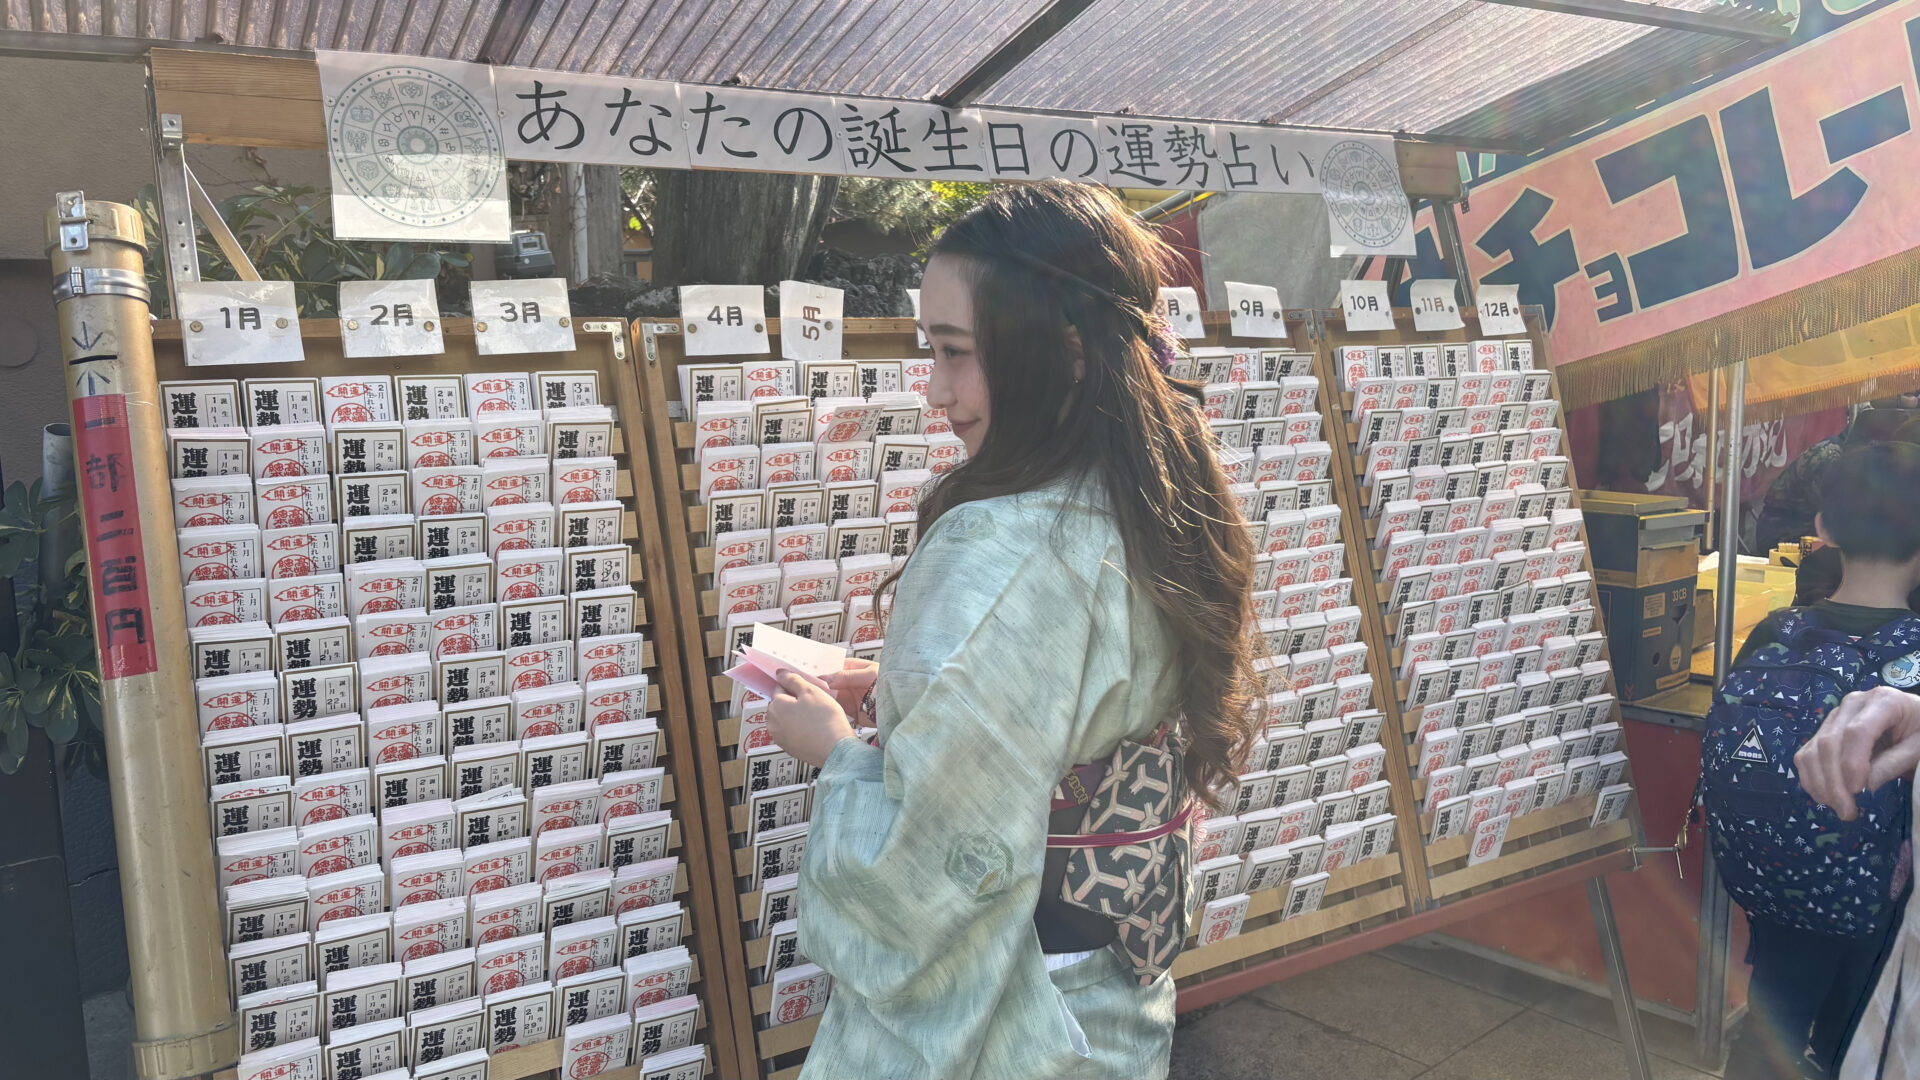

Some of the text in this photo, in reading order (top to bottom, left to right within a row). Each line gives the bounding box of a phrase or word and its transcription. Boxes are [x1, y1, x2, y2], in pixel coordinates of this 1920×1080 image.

[516, 80, 1316, 188] あなたの誕生日の運勢占い
[1240, 299, 1264, 317] 9月
[1350, 295, 1380, 312] 10月
[1421, 297, 1446, 313] 11月
[500, 301, 542, 325] 3月
[1484, 302, 1510, 318] 12月
[219, 307, 262, 331] 1月
[370, 303, 414, 327] 2月
[707, 305, 744, 327] 4月
[803, 305, 821, 341] 5月
[482, 382, 504, 391] 開運
[862, 369, 876, 402] 運勢
[338, 387, 359, 396] 開運
[378, 384, 387, 419] 2月1日
[710, 421, 727, 429] 開運
[422, 435, 444, 444] 開運
[270, 443, 292, 451] 開運
[312, 440, 322, 474] 1月17日
[774, 456, 792, 464] 開運
[718, 461, 735, 469] 開運
[570, 472, 589, 480] 開運
[432, 478, 454, 486] 開運
[498, 479, 519, 487] 開運
[274, 490, 296, 498] 開運
[193, 496, 216, 505] 開運
[715, 504, 733, 535] 運勢
[280, 539, 302, 547] 開運
[787, 538, 804, 547] 開運
[197, 546, 221, 555] 開運
[727, 546, 745, 554] 開運
[512, 566, 532, 575] 開運
[576, 559, 596, 591] 運勢
[372, 581, 393, 589] 開運
[799, 581, 817, 589] 開運
[286, 590, 309, 598] 開運
[737, 587, 755, 596] 開運
[445, 618, 466, 626] 開運
[581, 604, 602, 638] 運勢
[511, 612, 531, 647] 運勢
[594, 647, 614, 655] 開運
[519, 655, 540, 664] 開運
[447, 668, 469, 703] 運勢
[292, 678, 317, 720] 運勢
[327, 682, 339, 709] 1月22日
[601, 695, 621, 703] 開運
[217, 696, 241, 705] 開運
[533, 707, 552, 715] 開運
[386, 727, 407, 736] 開運
[453, 716, 474, 749] 運勢
[298, 739, 323, 776] 運勢
[332, 740, 346, 768] 1月23日
[602, 744, 625, 775] 運勢
[531, 755, 553, 792] 運勢
[751, 760, 771, 791] 運勢
[312, 789, 334, 798] 開運
[613, 787, 633, 796] 開運
[758, 801, 777, 832] 運勢
[316, 841, 339, 850] 開運
[613, 838, 634, 872] 運勢
[479, 861, 500, 871] 開運
[763, 848, 782, 879] 運勢
[628, 883, 647, 892] 開運
[327, 891, 350, 900] 開運
[412, 927, 434, 936] 開運
[566, 944, 586, 953] 開運
[644, 976, 662, 984] 開運
[788, 984, 806, 992] 開運
[332, 995, 357, 1030] 運勢
[567, 990, 589, 1026] 運勢
[524, 1008, 537, 1034] 2月29日
[495, 1007, 516, 1045] 運勢
[251, 1011, 276, 1051] 運勢
[582, 1040, 602, 1049] 開運
[642, 1024, 664, 1056] 運勢
[421, 1029, 445, 1064] 運勢
